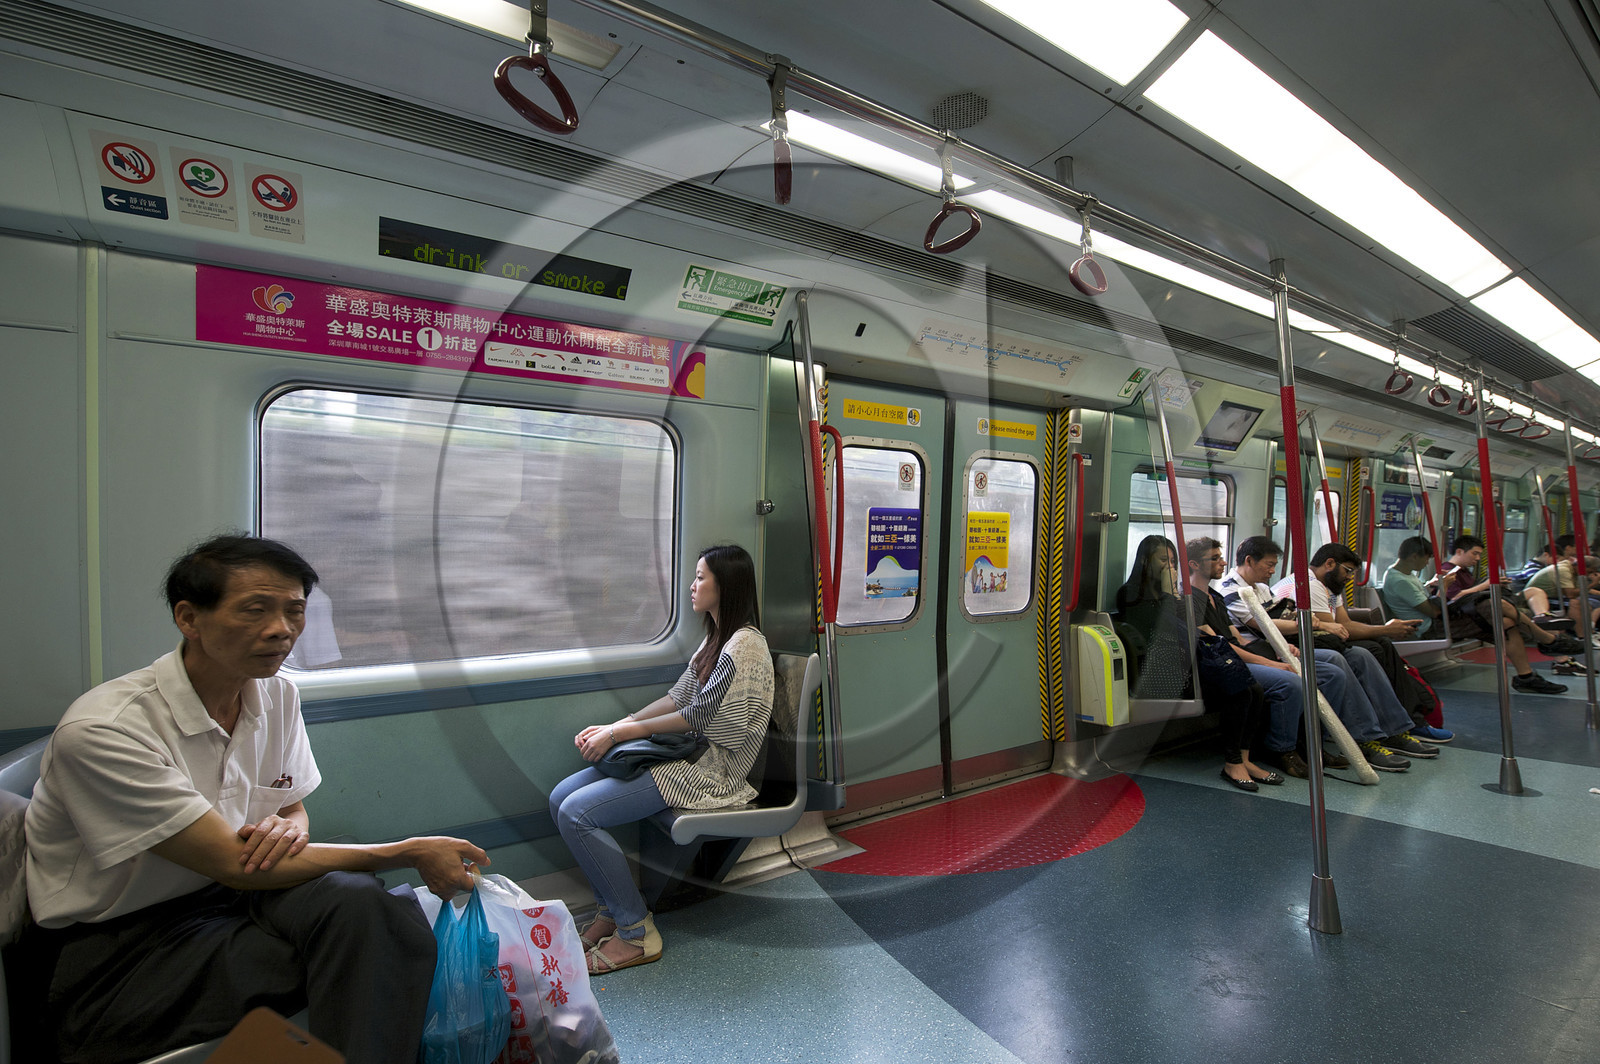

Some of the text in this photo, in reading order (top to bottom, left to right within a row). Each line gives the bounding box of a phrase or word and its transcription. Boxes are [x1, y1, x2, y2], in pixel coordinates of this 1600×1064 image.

[413, 243, 488, 273] drink
[502, 262, 530, 279] or
[542, 270, 605, 295] smoke
[717, 276, 758, 292] 緊急出口
[713, 286, 744, 297] Emergency
[244, 312, 305, 328] 華盛奧特萊斯
[255, 324, 296, 336] 購物中心
[847, 404, 904, 420] 請小心月台空隙
[991, 424, 1006, 432] Please
[870, 534, 917, 543] 就如三亞一樣美
